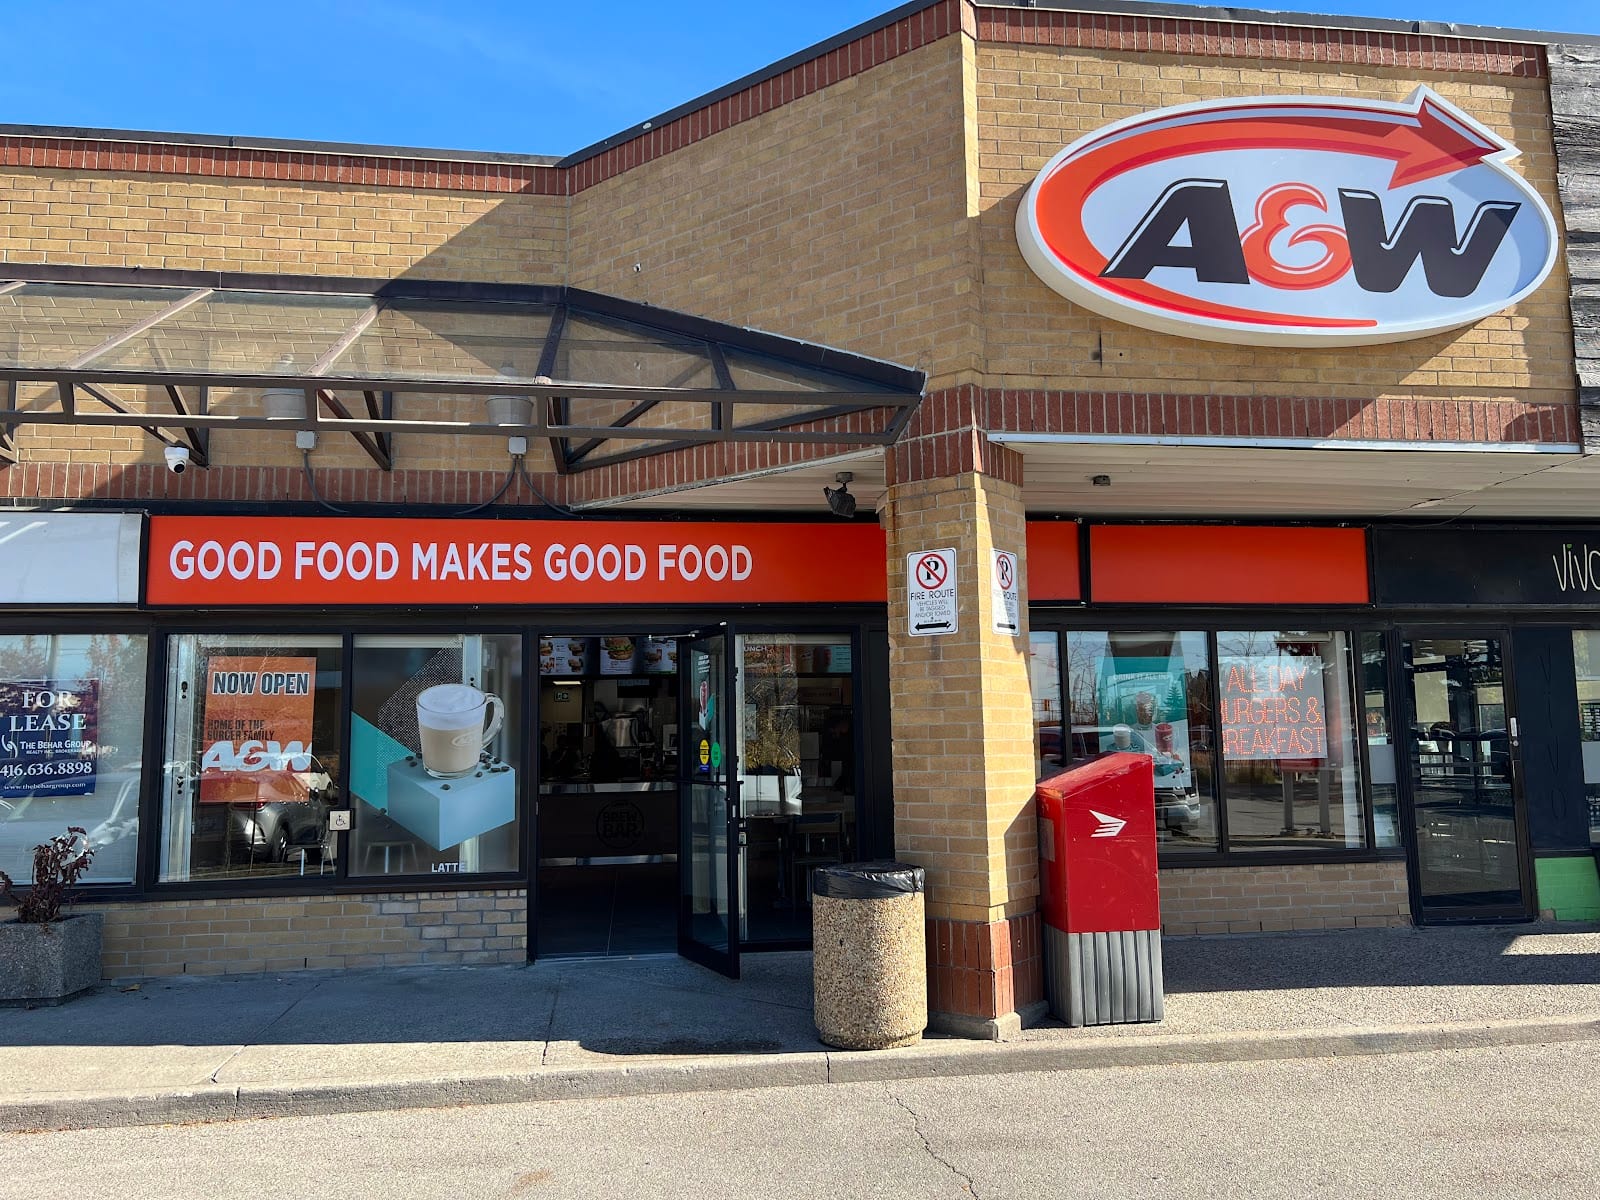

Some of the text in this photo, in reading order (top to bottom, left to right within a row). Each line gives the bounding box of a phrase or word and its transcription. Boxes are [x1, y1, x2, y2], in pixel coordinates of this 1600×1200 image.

[1099, 177, 1522, 299] A&W
[169, 540, 752, 581] GOOD FOOD MAKES GOOD FOOD
[911, 588, 954, 600] FIRE ROUTE
[213, 671, 310, 695] NOW OPEN
[1227, 665, 1307, 693] ALL DAY
[22, 690, 76, 709] FOR
[1306, 696, 1322, 724] &
[9, 713, 87, 732] LEASE
[208, 719, 265, 730] HOME OF THE
[208, 730, 275, 740] BURGER FAMILY
[20, 739, 92, 750] THE BEHAR GROUP
[0, 761, 92, 777] 416.636.8898
[4, 782, 86, 791] www.thebehargroup.com
[431, 862, 466, 873] LATTE
